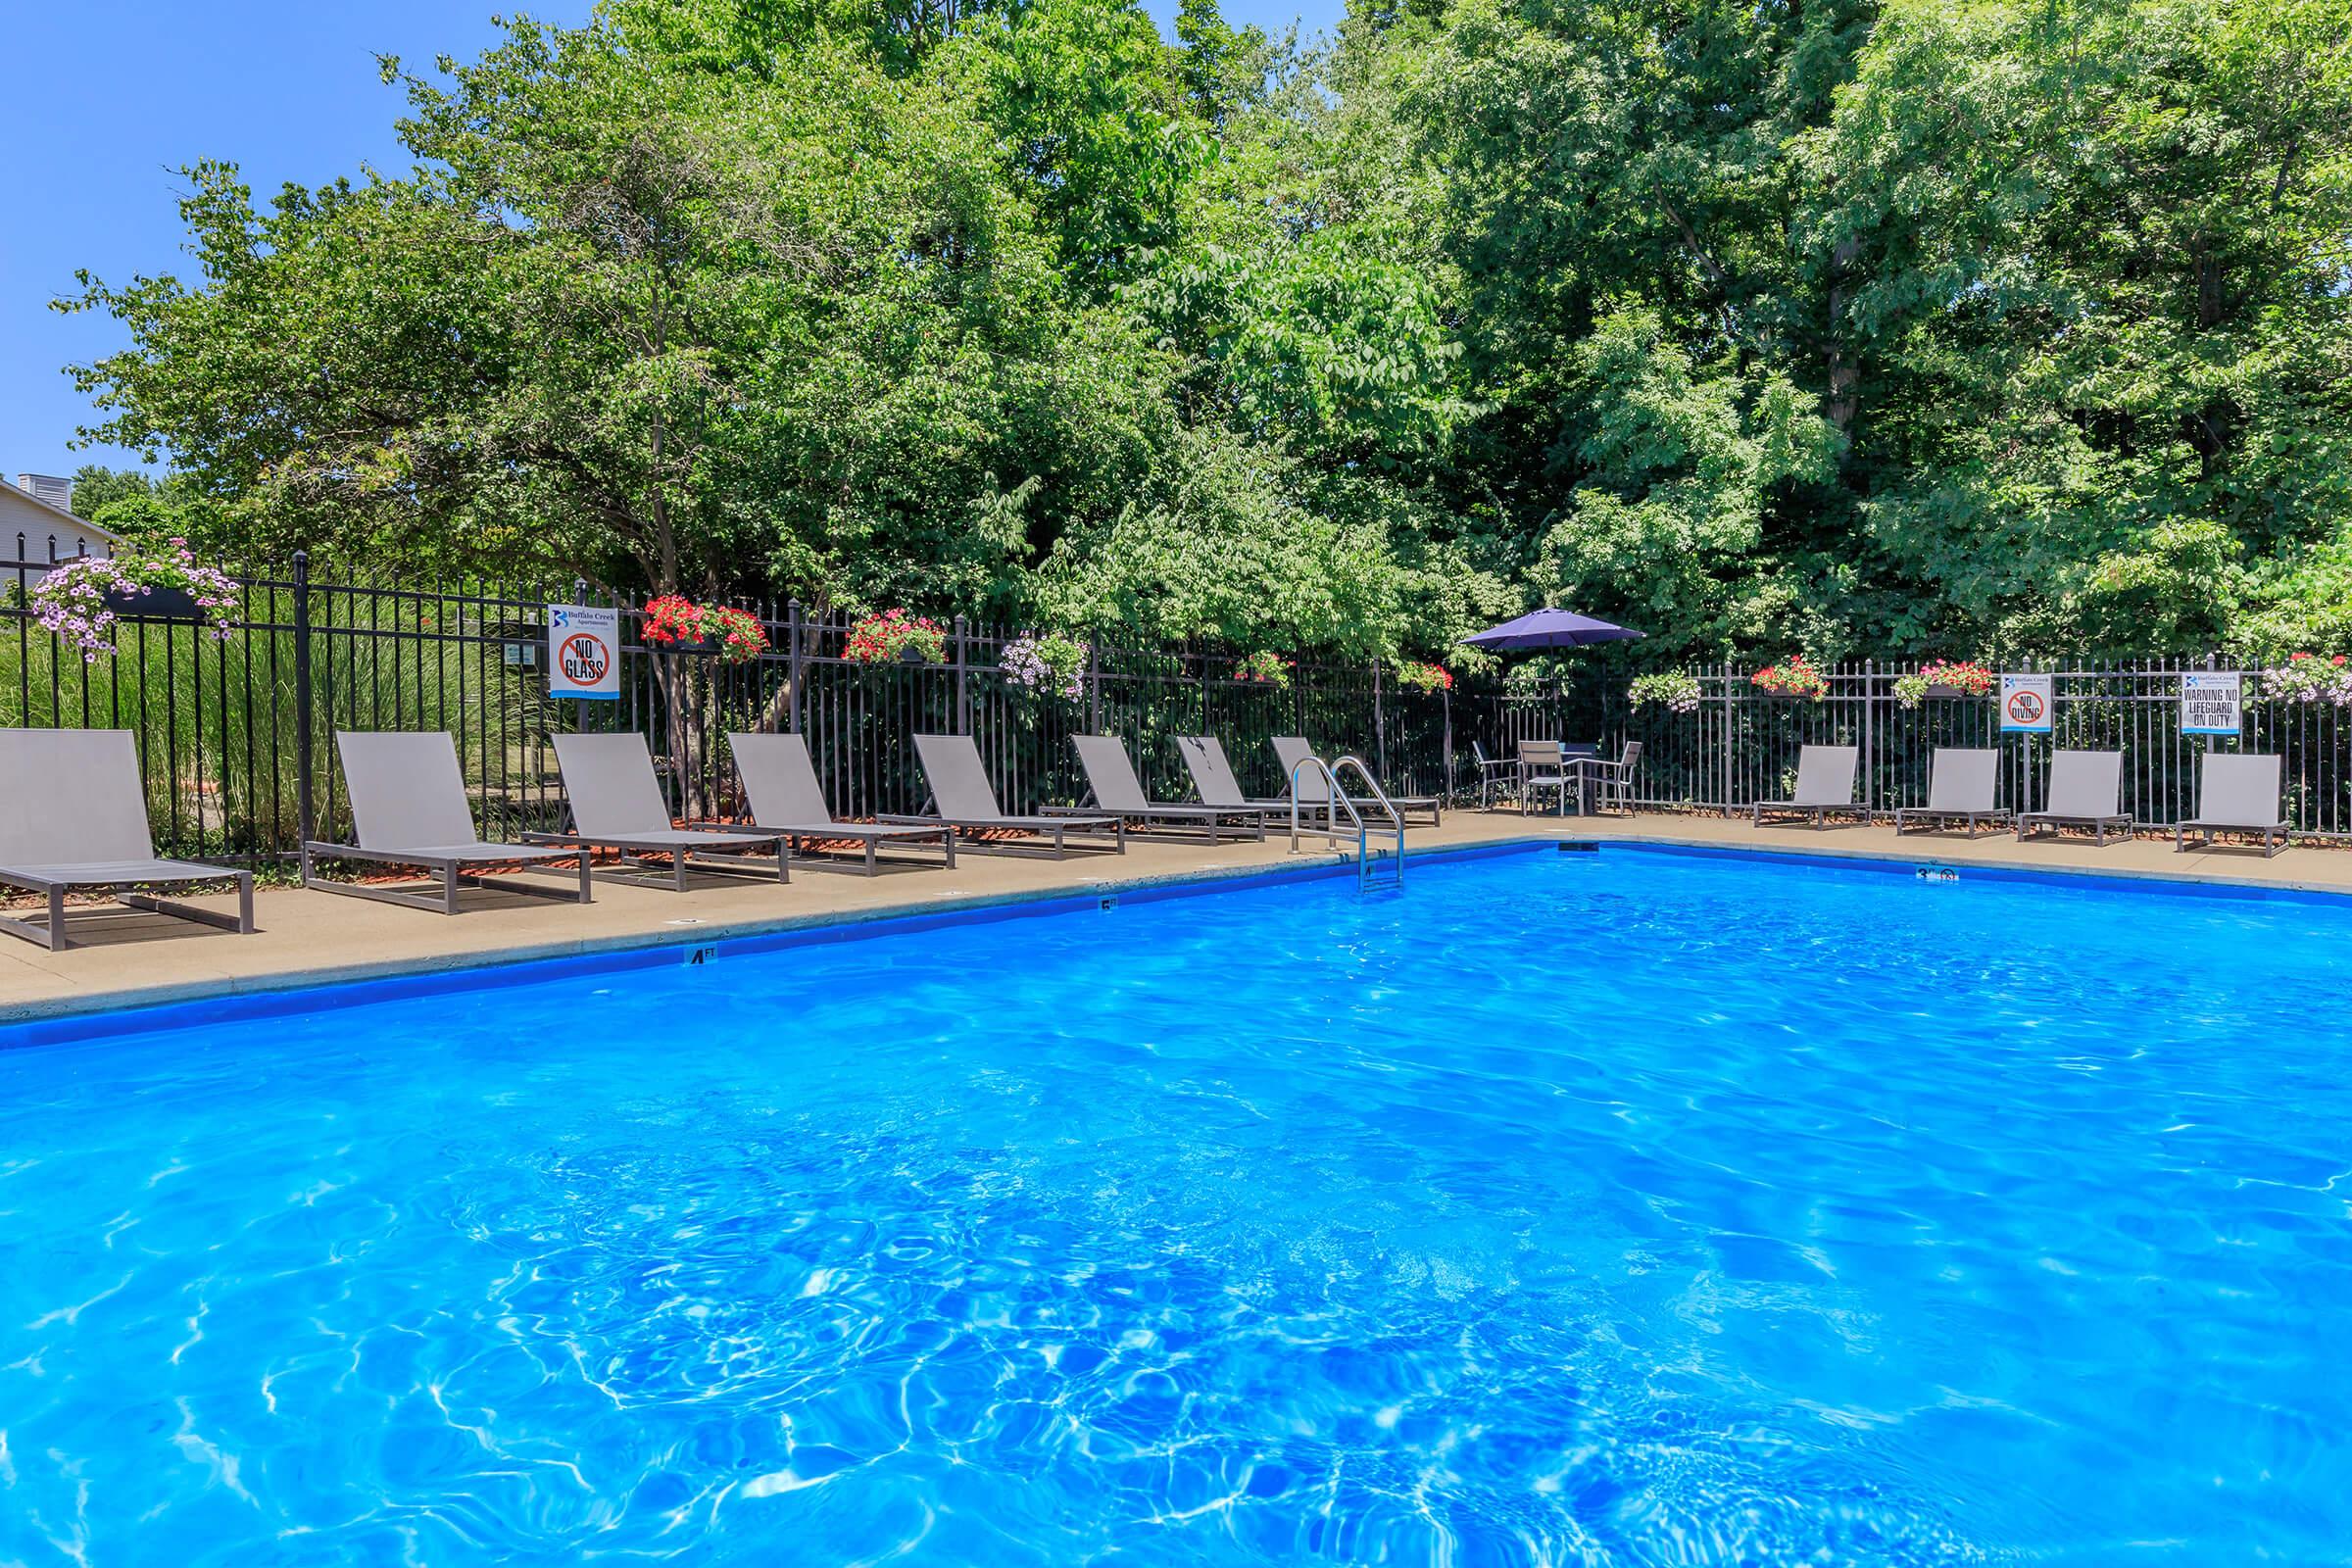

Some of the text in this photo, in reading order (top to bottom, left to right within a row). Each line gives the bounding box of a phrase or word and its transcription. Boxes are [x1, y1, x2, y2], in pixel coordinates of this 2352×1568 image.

[568, 611, 593, 619] Buffalo
[575, 640, 592, 659] NO
[565, 660, 603, 678] GLASS
[2184, 689, 2237, 701] WARNING NO
[2021, 696, 2032, 707] NO
[2189, 702, 2232, 713] LIFEGUARD
[2012, 708, 2040, 719] DIVING
[2194, 714, 2230, 726] ON DUTY
[706, 948, 715, 956] FT
